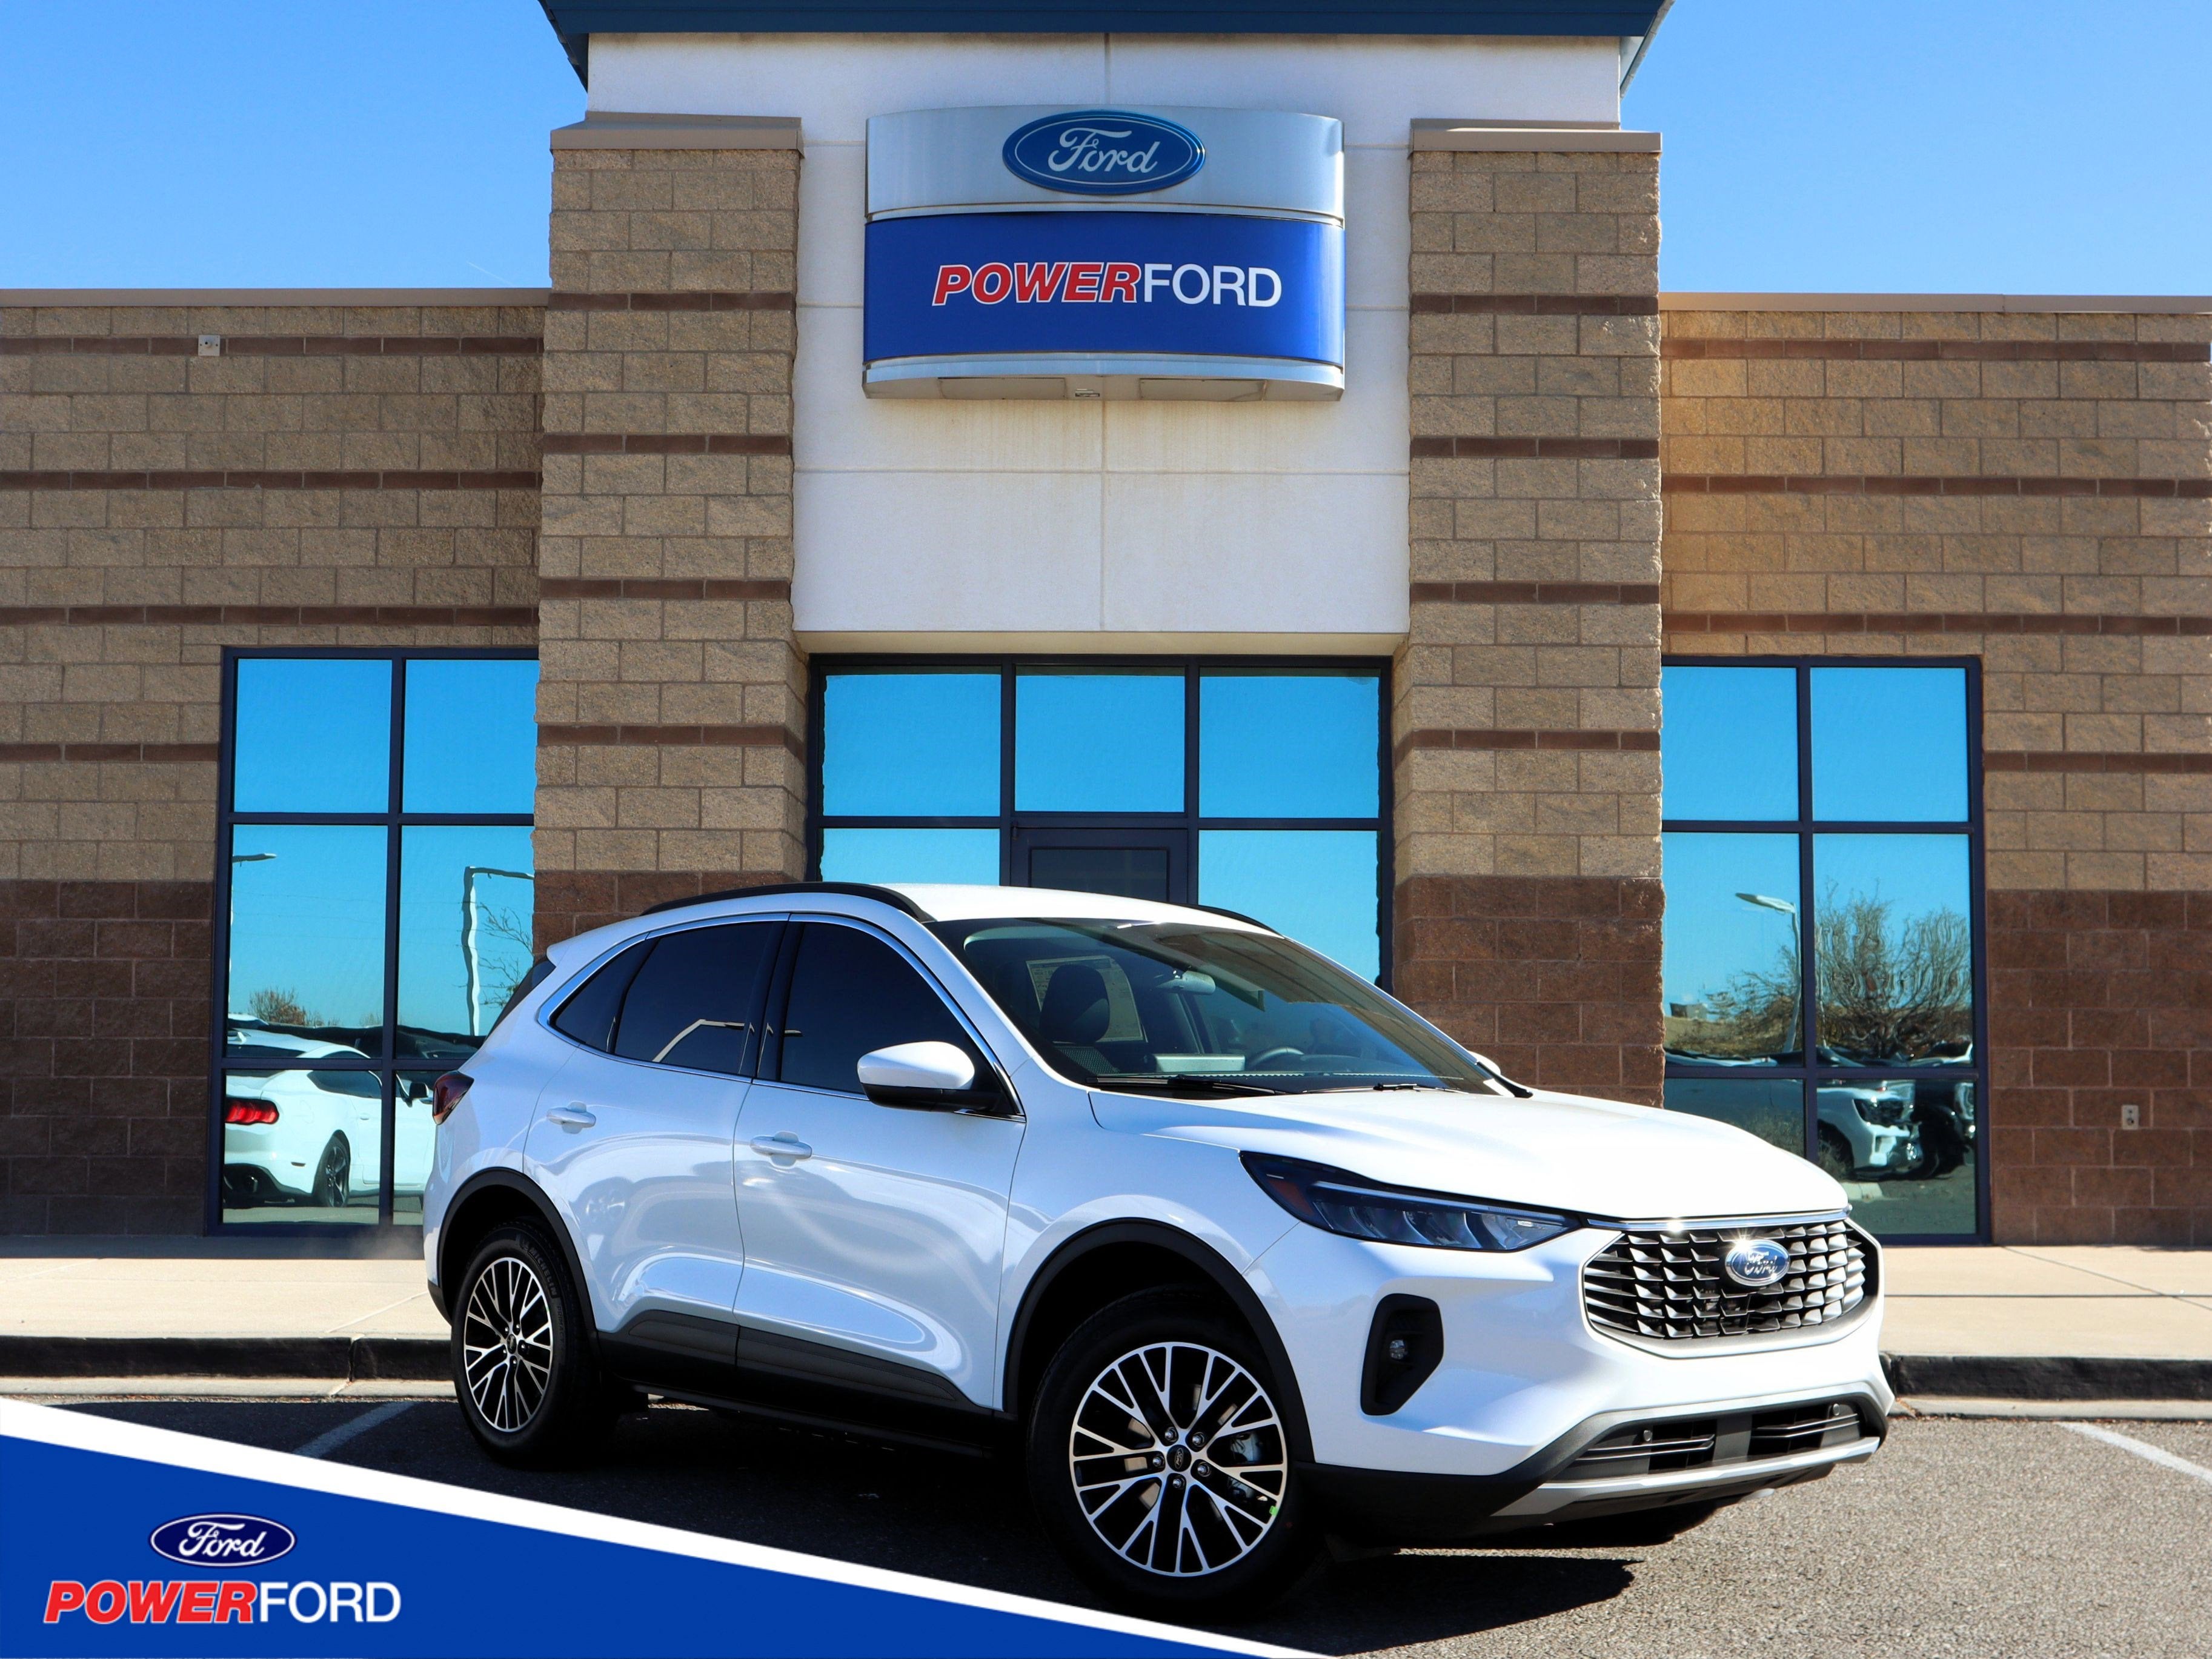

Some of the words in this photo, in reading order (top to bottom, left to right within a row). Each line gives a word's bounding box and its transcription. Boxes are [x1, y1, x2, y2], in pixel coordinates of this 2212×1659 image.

[1048, 128, 1160, 173] Ford
[530, 1246, 557, 1295] MICHELIN
[1745, 1250, 1778, 1275] Ford
